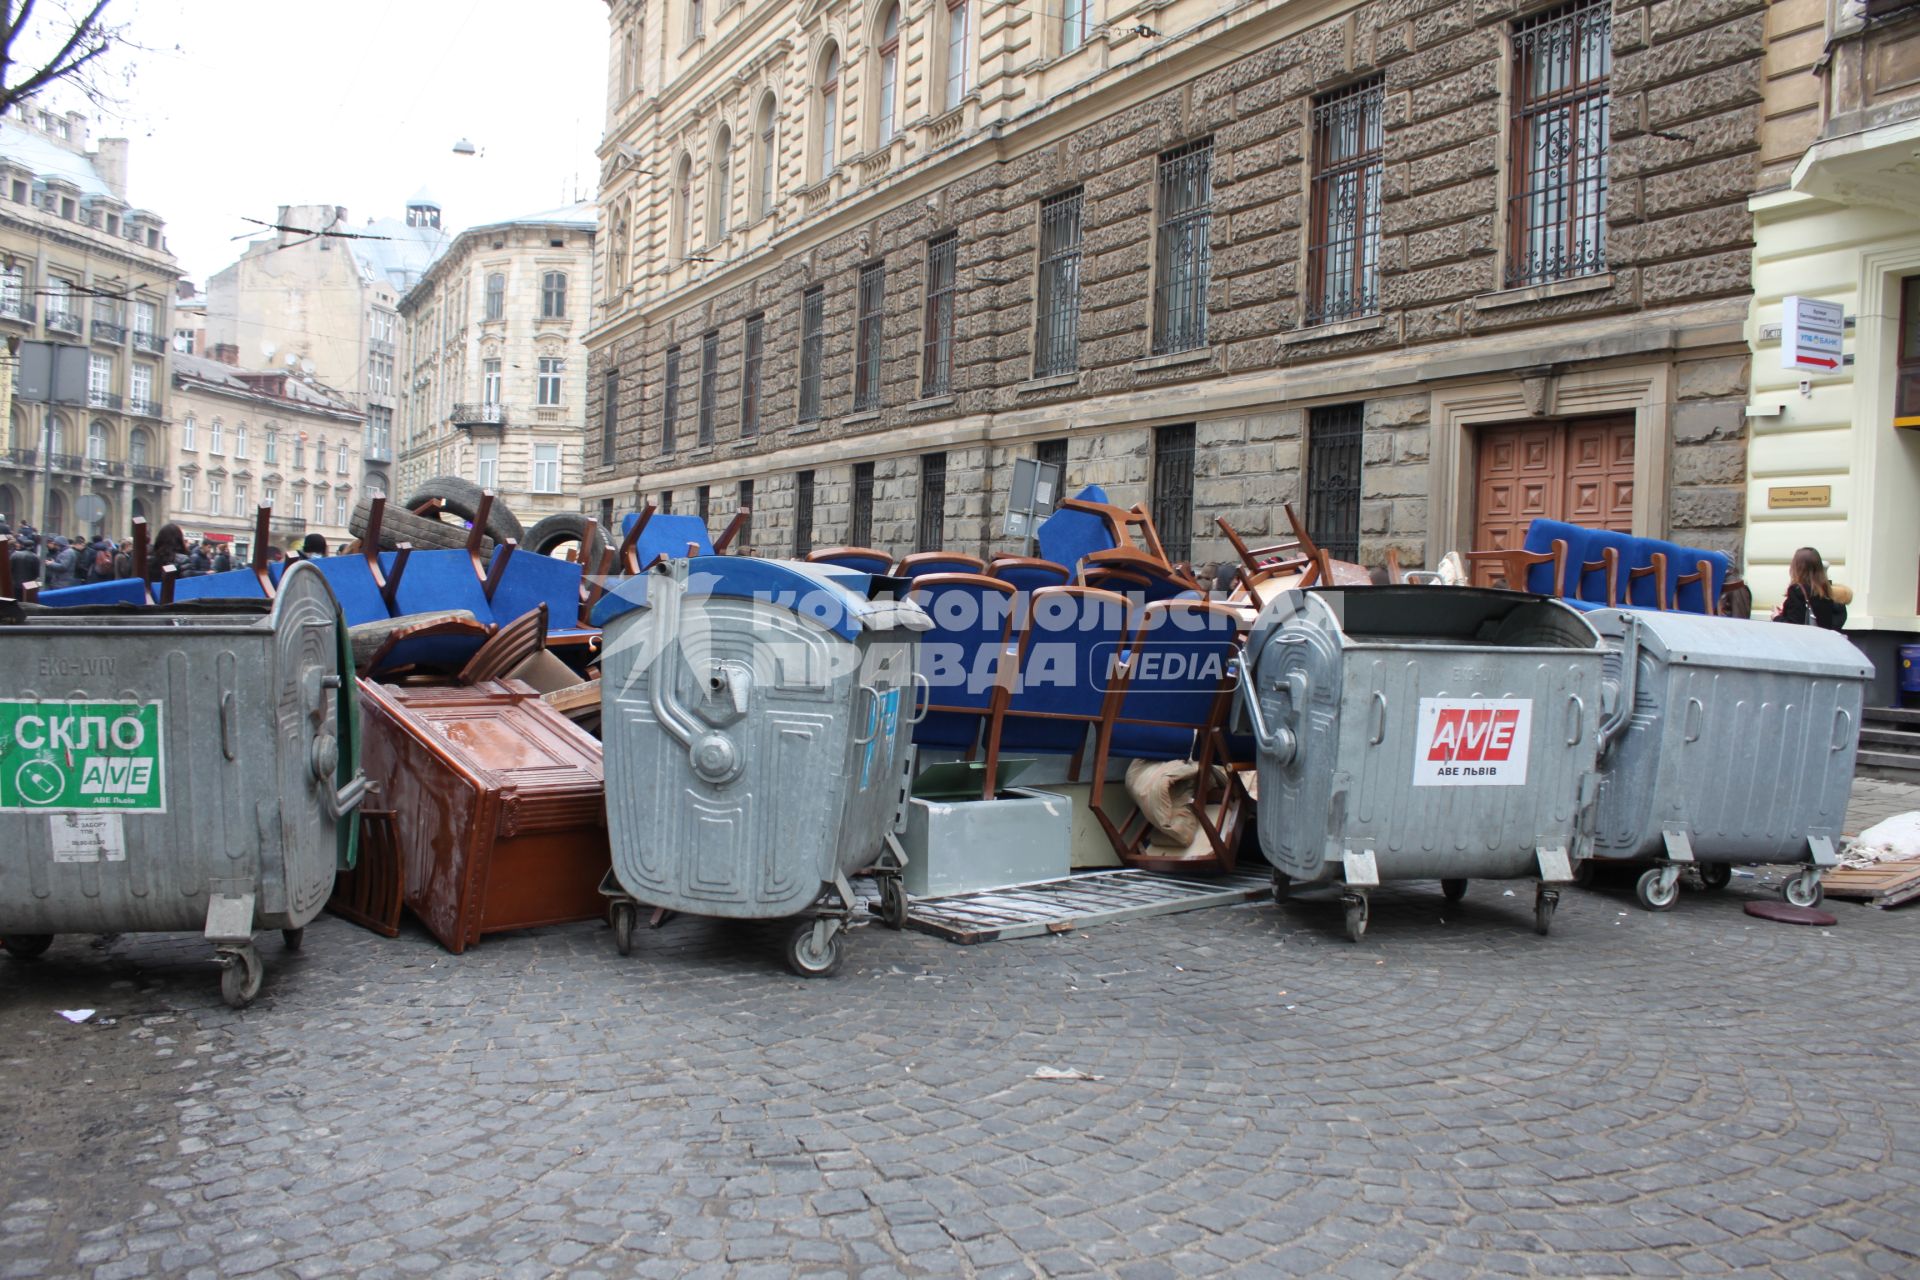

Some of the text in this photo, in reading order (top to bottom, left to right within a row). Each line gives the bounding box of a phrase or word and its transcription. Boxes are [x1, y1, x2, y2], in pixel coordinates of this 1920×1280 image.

[1820, 337, 1838, 345] БАНК
[15, 715, 145, 750] СКЛО
[1432, 722, 1515, 749] AVE
[83, 766, 149, 785] AVE
[1437, 767, 1497, 776] АВЕ ЛЬВІВ
